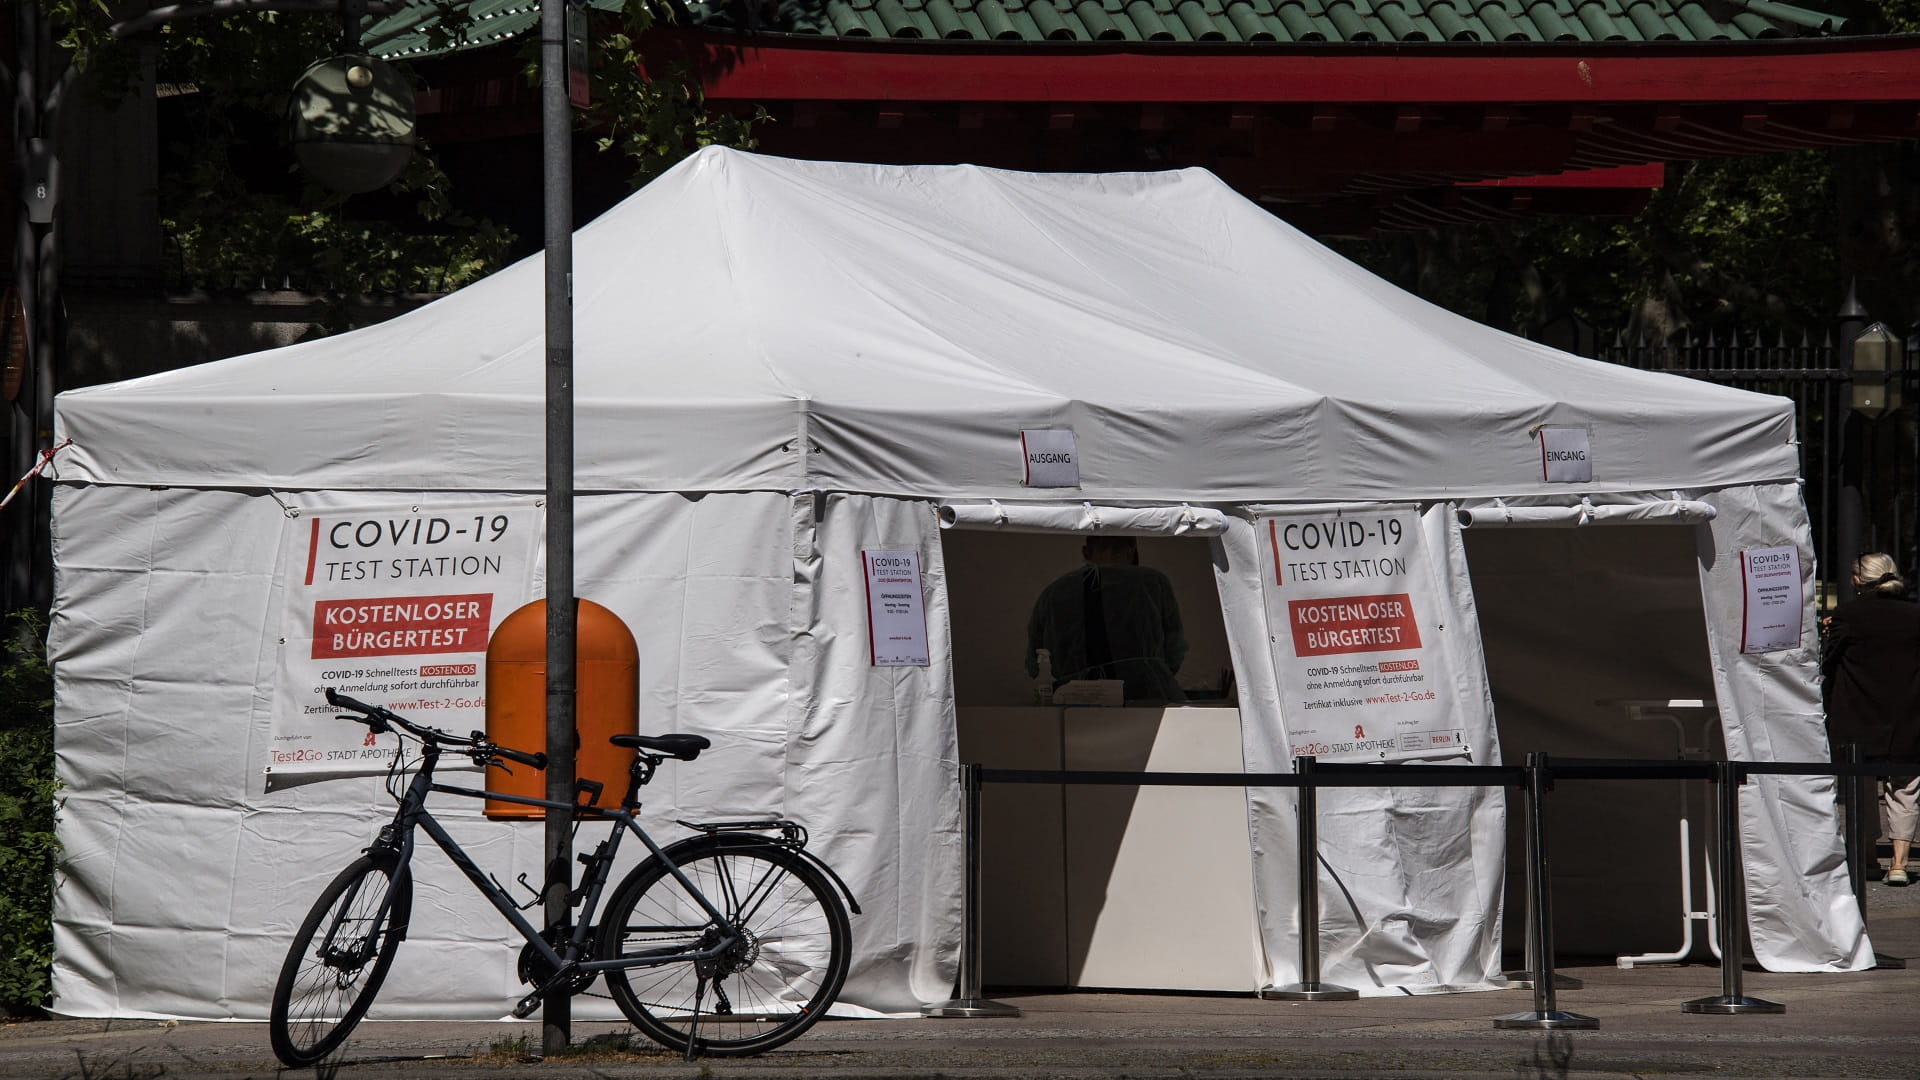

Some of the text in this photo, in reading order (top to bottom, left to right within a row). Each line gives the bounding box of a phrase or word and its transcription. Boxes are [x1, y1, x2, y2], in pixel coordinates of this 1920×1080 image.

[37, 186, 46, 199] 8
[1029, 453, 1071, 464] AUSGANG
[1546, 450, 1586, 462] EINGANG
[329, 514, 509, 549] COVID-19
[1284, 519, 1402, 550] COVID-19
[875, 558, 911, 567] COVID-19
[1752, 553, 1791, 564] COVID-19
[1767, 563, 1791, 571] STATION
[325, 555, 502, 582] TEST STATION
[1288, 557, 1406, 581] TEST STATION
[325, 601, 480, 625] KOSTENLOSER
[1297, 601, 1405, 624] KOSTENLOSER
[333, 628, 468, 651] BÜRGERTEST
[1307, 627, 1401, 649] BÜRGERTEST
[322, 665, 476, 680] COVID-19 Schnelltests KOSTENLOS
[1307, 660, 1418, 677] COVID-19 Schnelltests KOSTENLOS
[338, 682, 388, 693] Anmeldung
[390, 680, 418, 691] sofort
[420, 678, 480, 689] durchführbar
[1306, 673, 1424, 690] ohne Anmeldung sofort durchführbar
[304, 704, 343, 715] Zertifikat
[388, 697, 486, 710] www.Test-2-Go.de
[1304, 690, 1435, 710] Zertifikat inklusive www.Test-2-Go.de
[1290, 742, 1329, 756] Test2Go
[1331, 743, 1354, 753] STADT
[1356, 738, 1396, 751] APOTHEKE
[1432, 736, 1451, 744] BERLIN
[271, 747, 412, 762] Test2Go STADT APOTHEE
